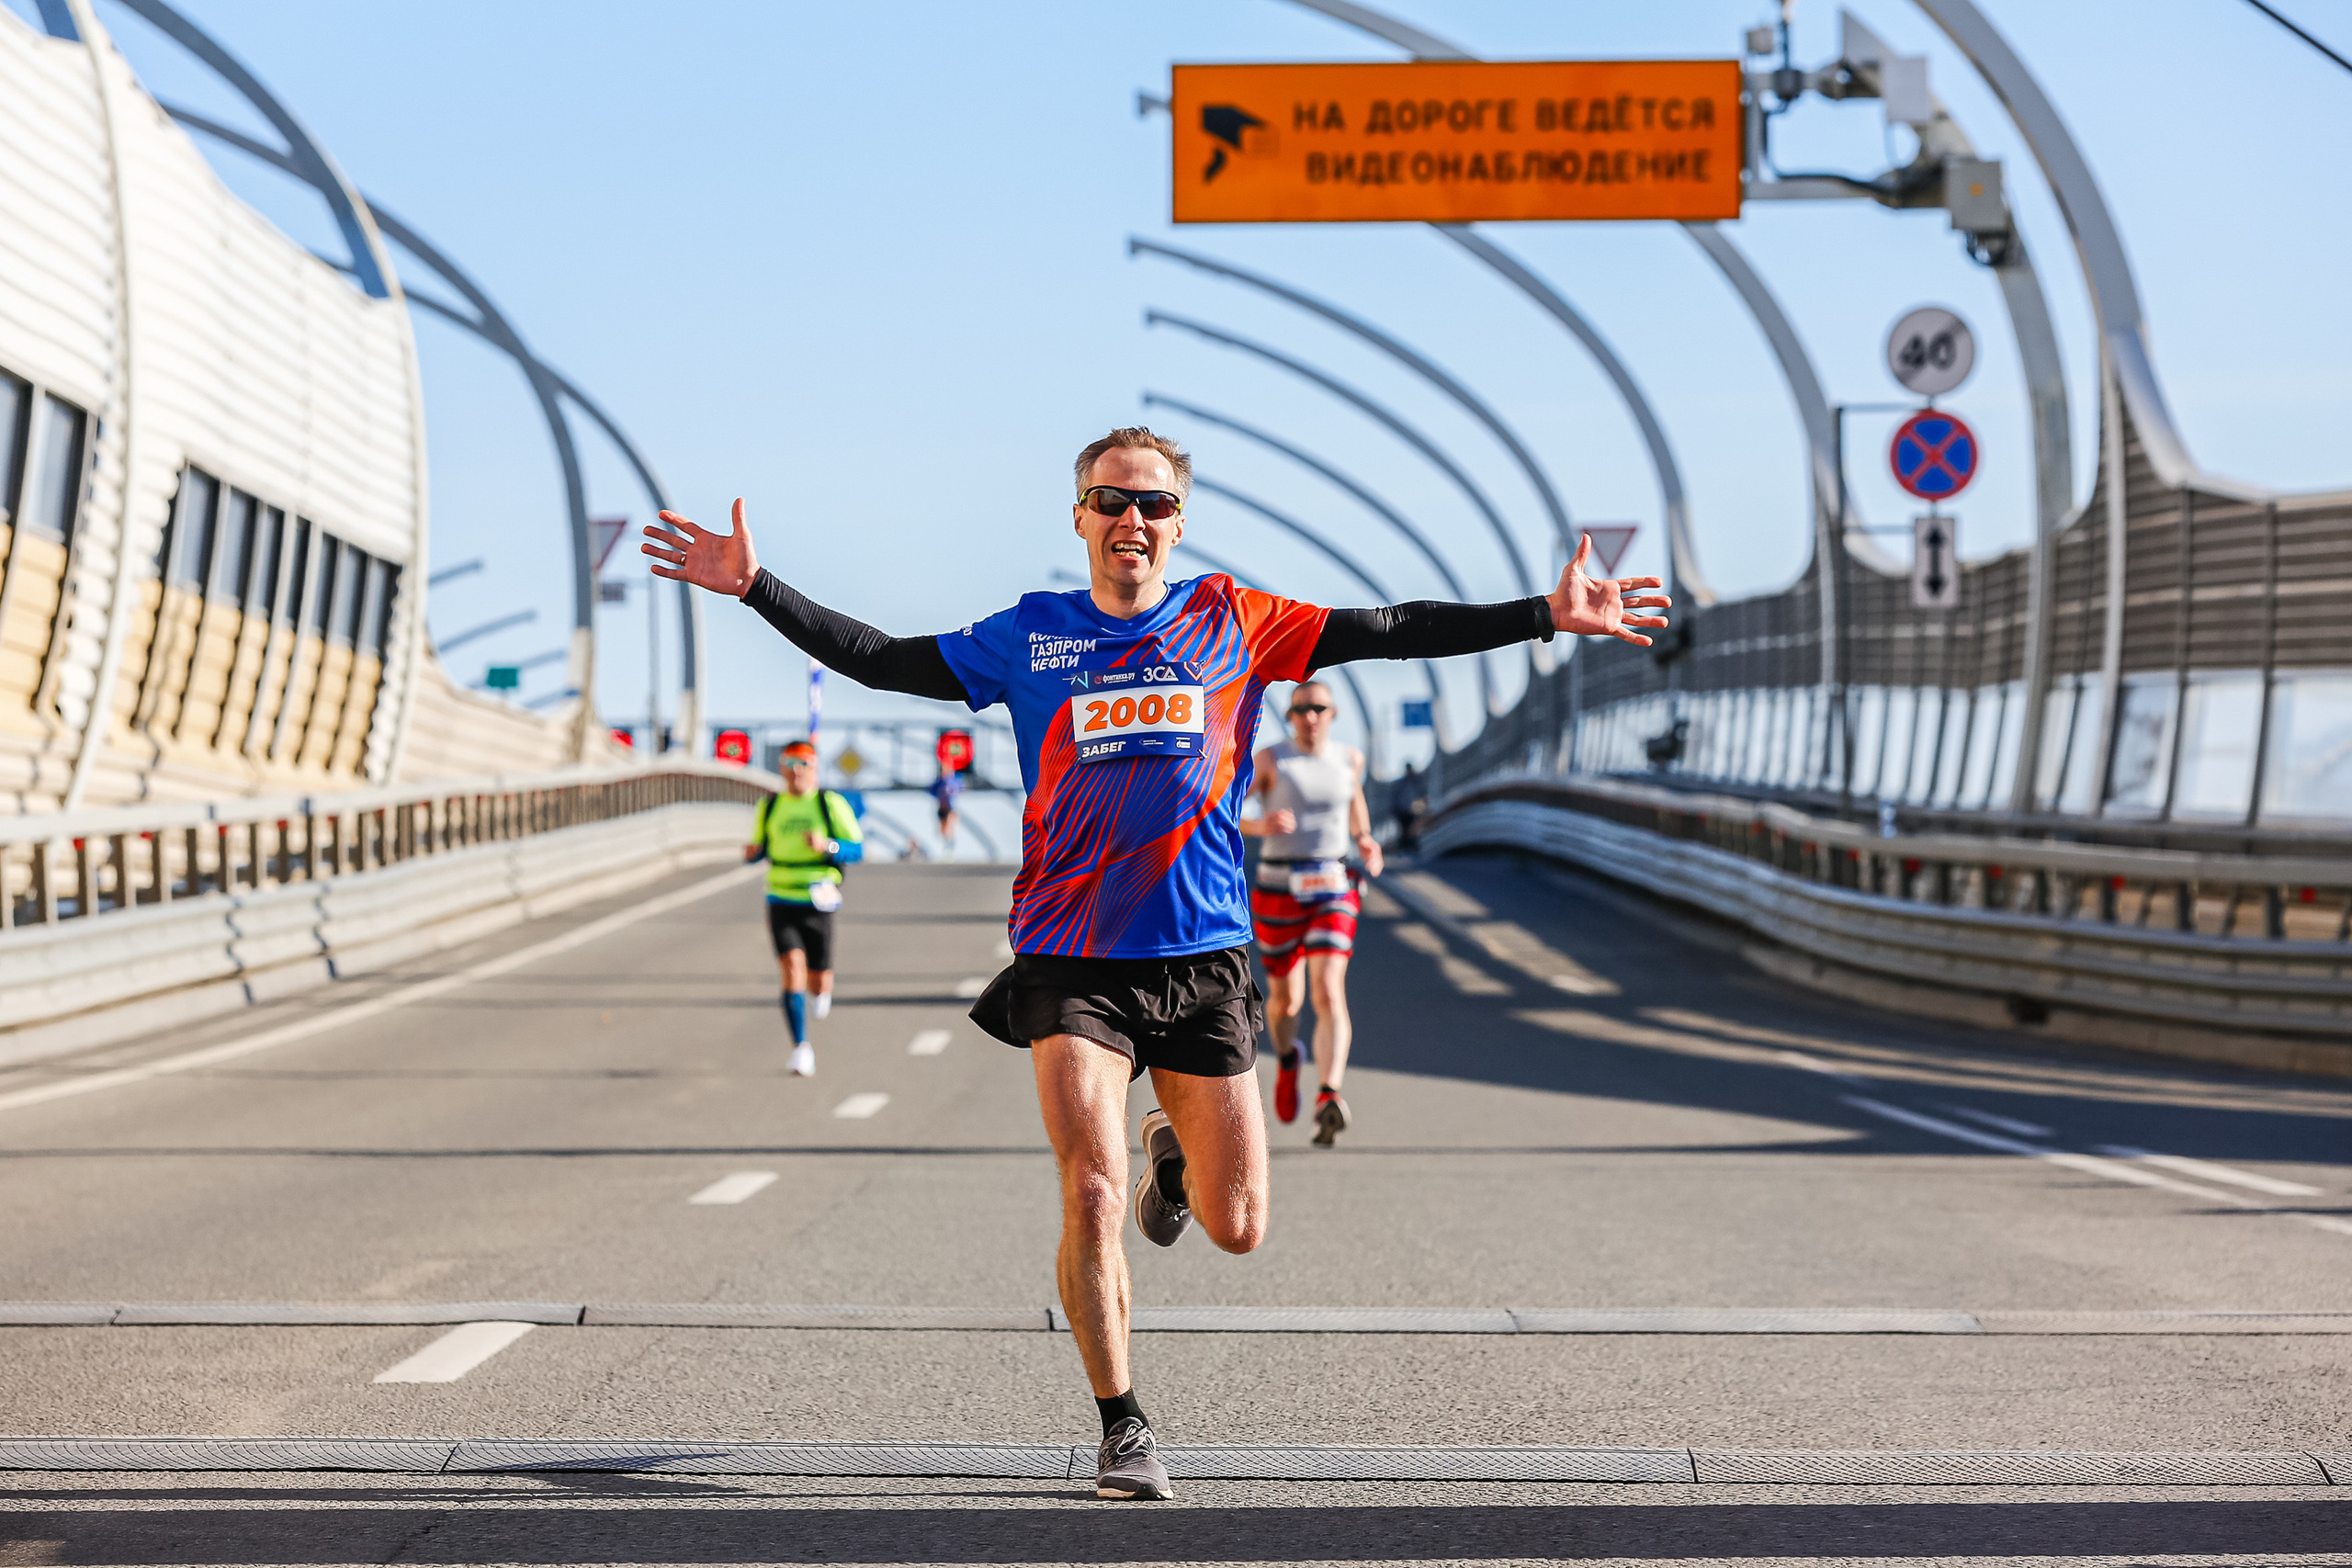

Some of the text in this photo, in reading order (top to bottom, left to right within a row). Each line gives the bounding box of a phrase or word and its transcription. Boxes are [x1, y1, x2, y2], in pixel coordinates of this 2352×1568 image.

[1293, 92, 1715, 134] НА ДОРОГЕ ВЕДЁТСЯ
[1306, 150, 1713, 186] ВИДЕОНАБЛЮДЕНИЕ
[1899, 333, 1957, 369] 40
[1030, 638, 1097, 658] ГАЗПРОМ
[1031, 654, 1080, 672] НЕФТИ
[1084, 694, 1193, 732] 2008
[1081, 740, 1126, 759] ЗАБЕГ
